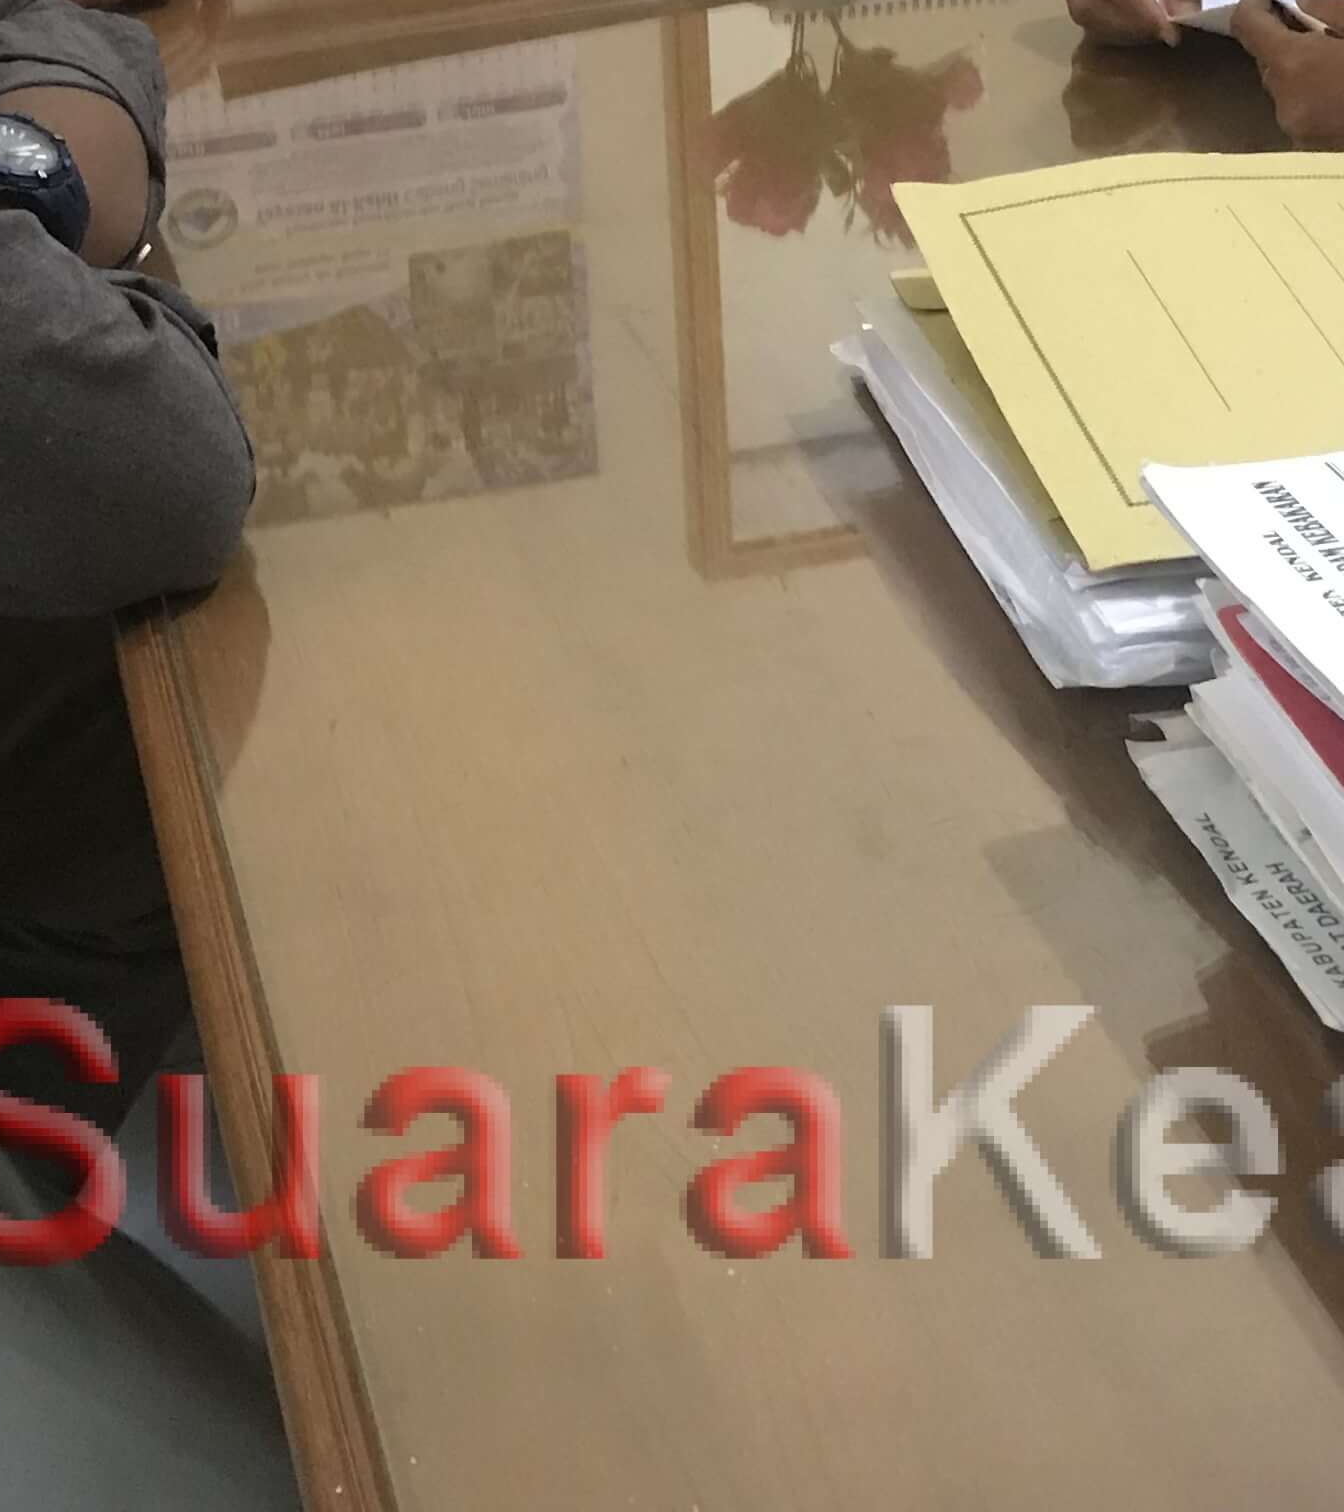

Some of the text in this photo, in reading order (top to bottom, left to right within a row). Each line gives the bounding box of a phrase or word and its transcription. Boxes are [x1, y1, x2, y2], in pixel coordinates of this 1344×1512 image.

[1255, 482, 1337, 545] KEBAKARAN
[1264, 533, 1321, 581] KENDAL
[1194, 811, 1259, 888] KENDAL
[1255, 861, 1340, 929] DAERAH
